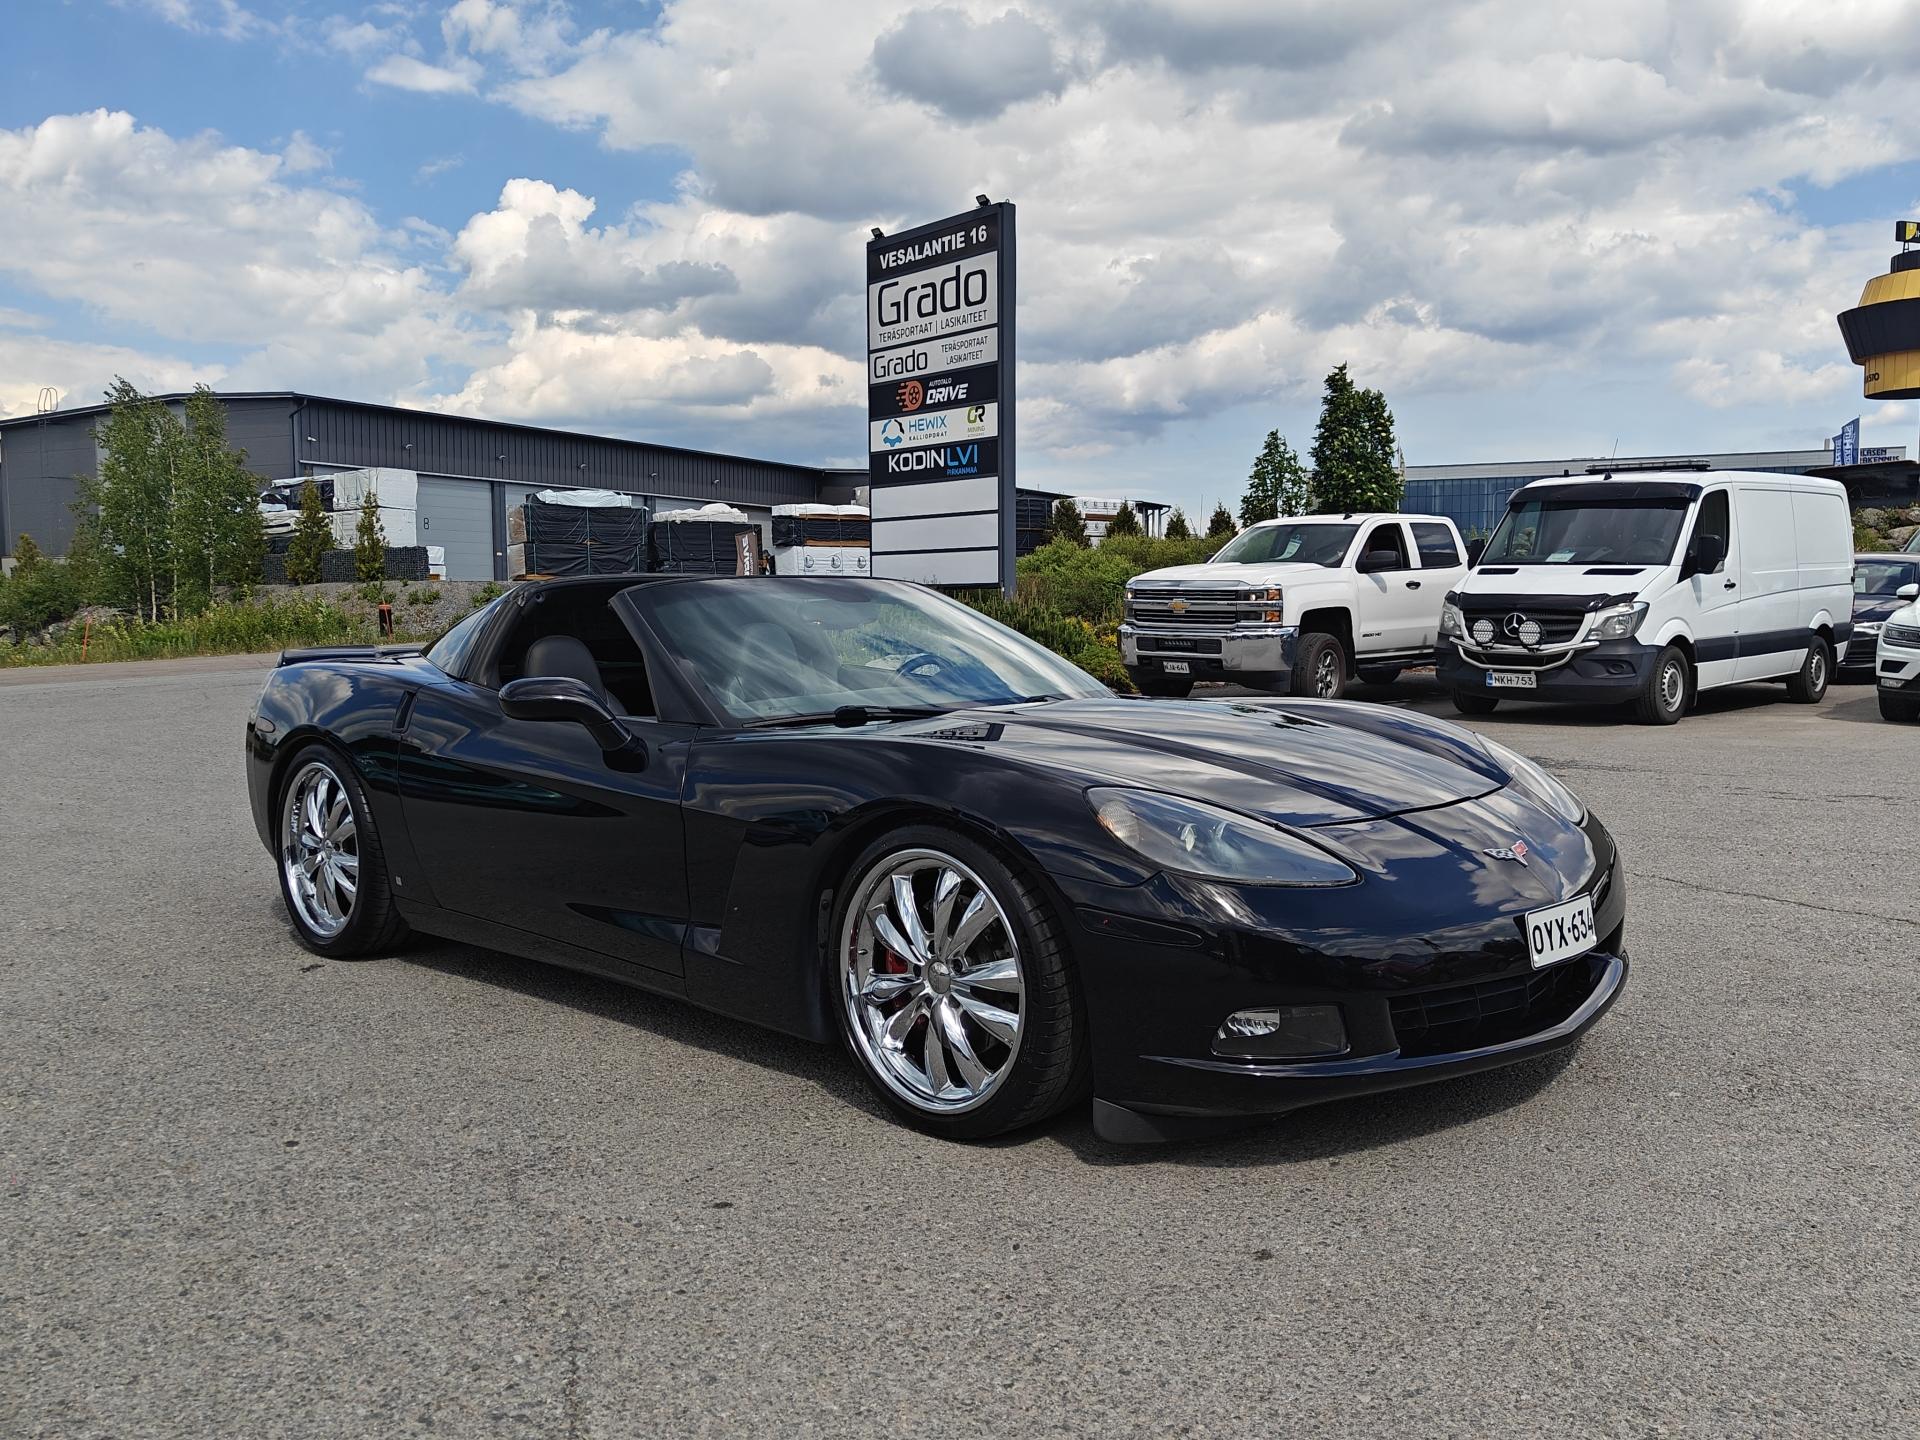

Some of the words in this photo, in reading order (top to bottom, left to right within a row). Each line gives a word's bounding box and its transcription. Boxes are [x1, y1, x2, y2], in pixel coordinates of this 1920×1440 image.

[880, 231, 965, 269] VESALANTIE
[970, 225, 987, 245] 16
[878, 265, 987, 327] Grado
[879, 322, 932, 343] TERÄSPORTAAT
[941, 310, 987, 329] LASIKAITEET
[941, 336, 988, 353] TERÄSPORTAAT
[874, 349, 928, 378] Grado
[947, 350, 983, 365] LASIKAITEET
[926, 383, 968, 404] DRIVE
[909, 415, 948, 432] HEWIX
[909, 431, 947, 441] KALLIOPORAT
[947, 466, 977, 476] PIRKANMAA
[424, 517, 429, 530] B
[1494, 675, 1534, 686] NKH-753
[1532, 907, 1594, 955] OYX-634
